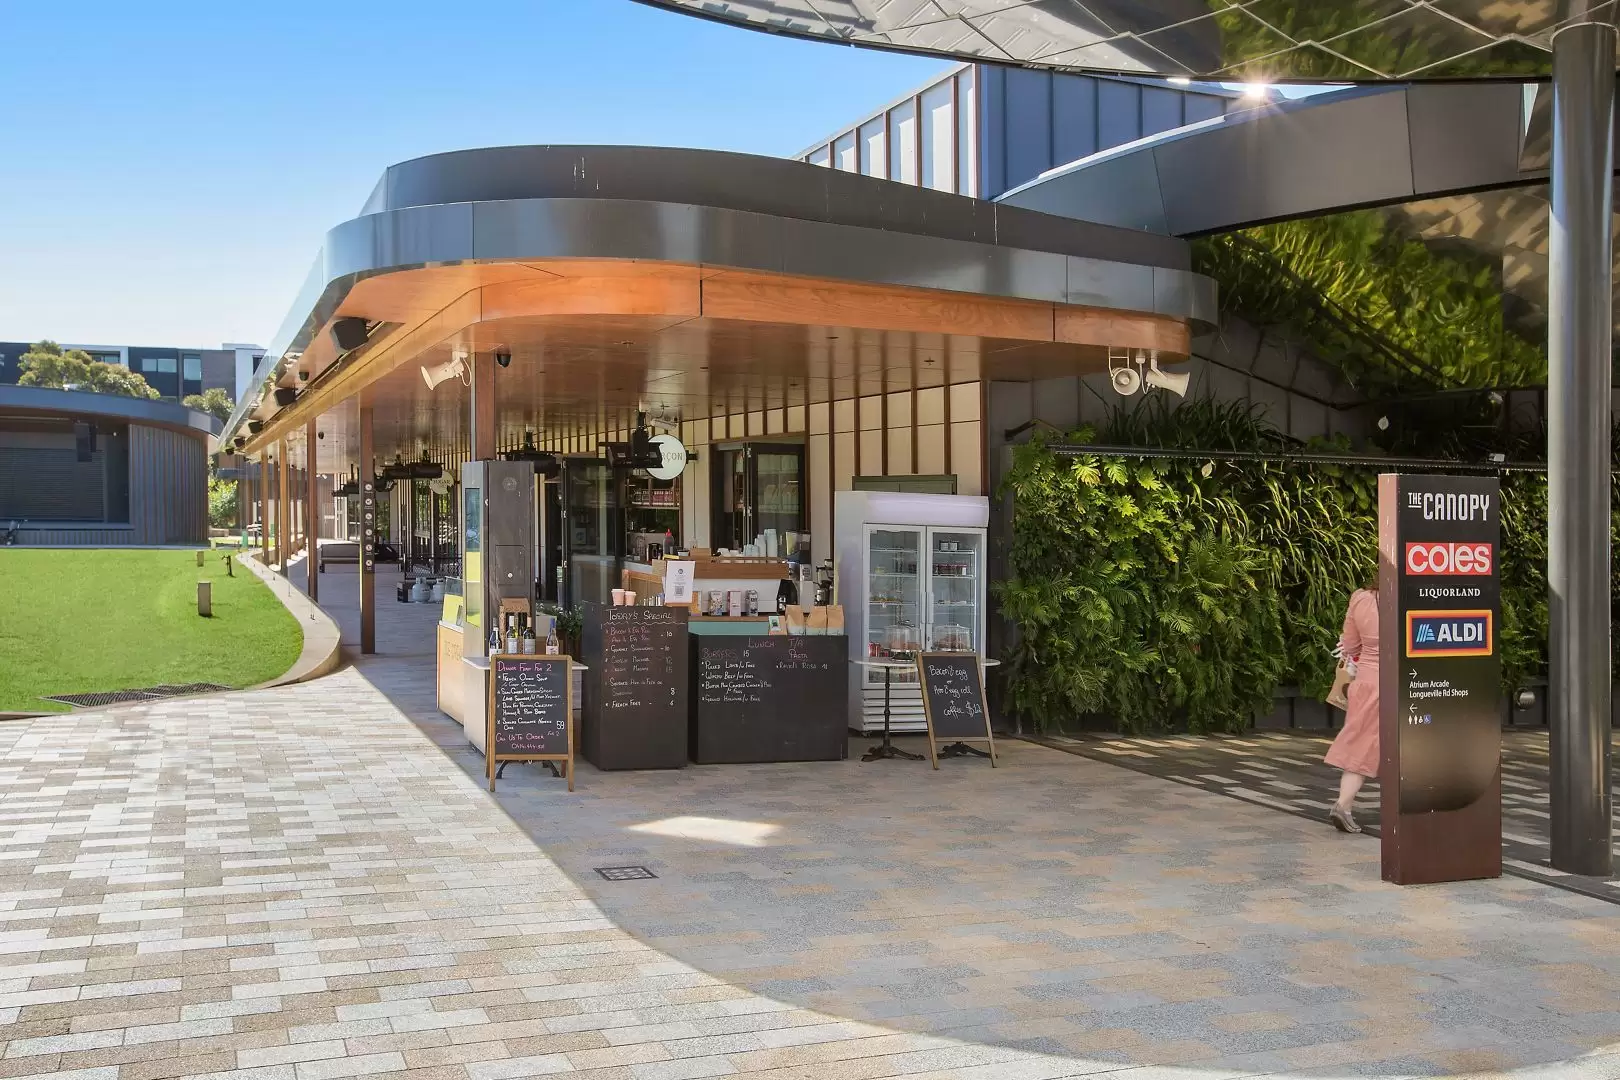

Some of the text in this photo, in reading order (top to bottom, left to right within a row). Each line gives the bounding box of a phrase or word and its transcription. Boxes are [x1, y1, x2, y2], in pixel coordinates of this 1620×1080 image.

[1408, 493, 1490, 521] THE CANOPY
[1408, 543, 1490, 573] coles
[1419, 588, 1481, 598] LIQUORLAND
[644, 610, 672, 620] SPECIAL
[1437, 623, 1483, 642] ALDI
[1409, 680, 1450, 688] Atrium Arcade
[1409, 688, 1468, 699] Longueville Rd Shops
